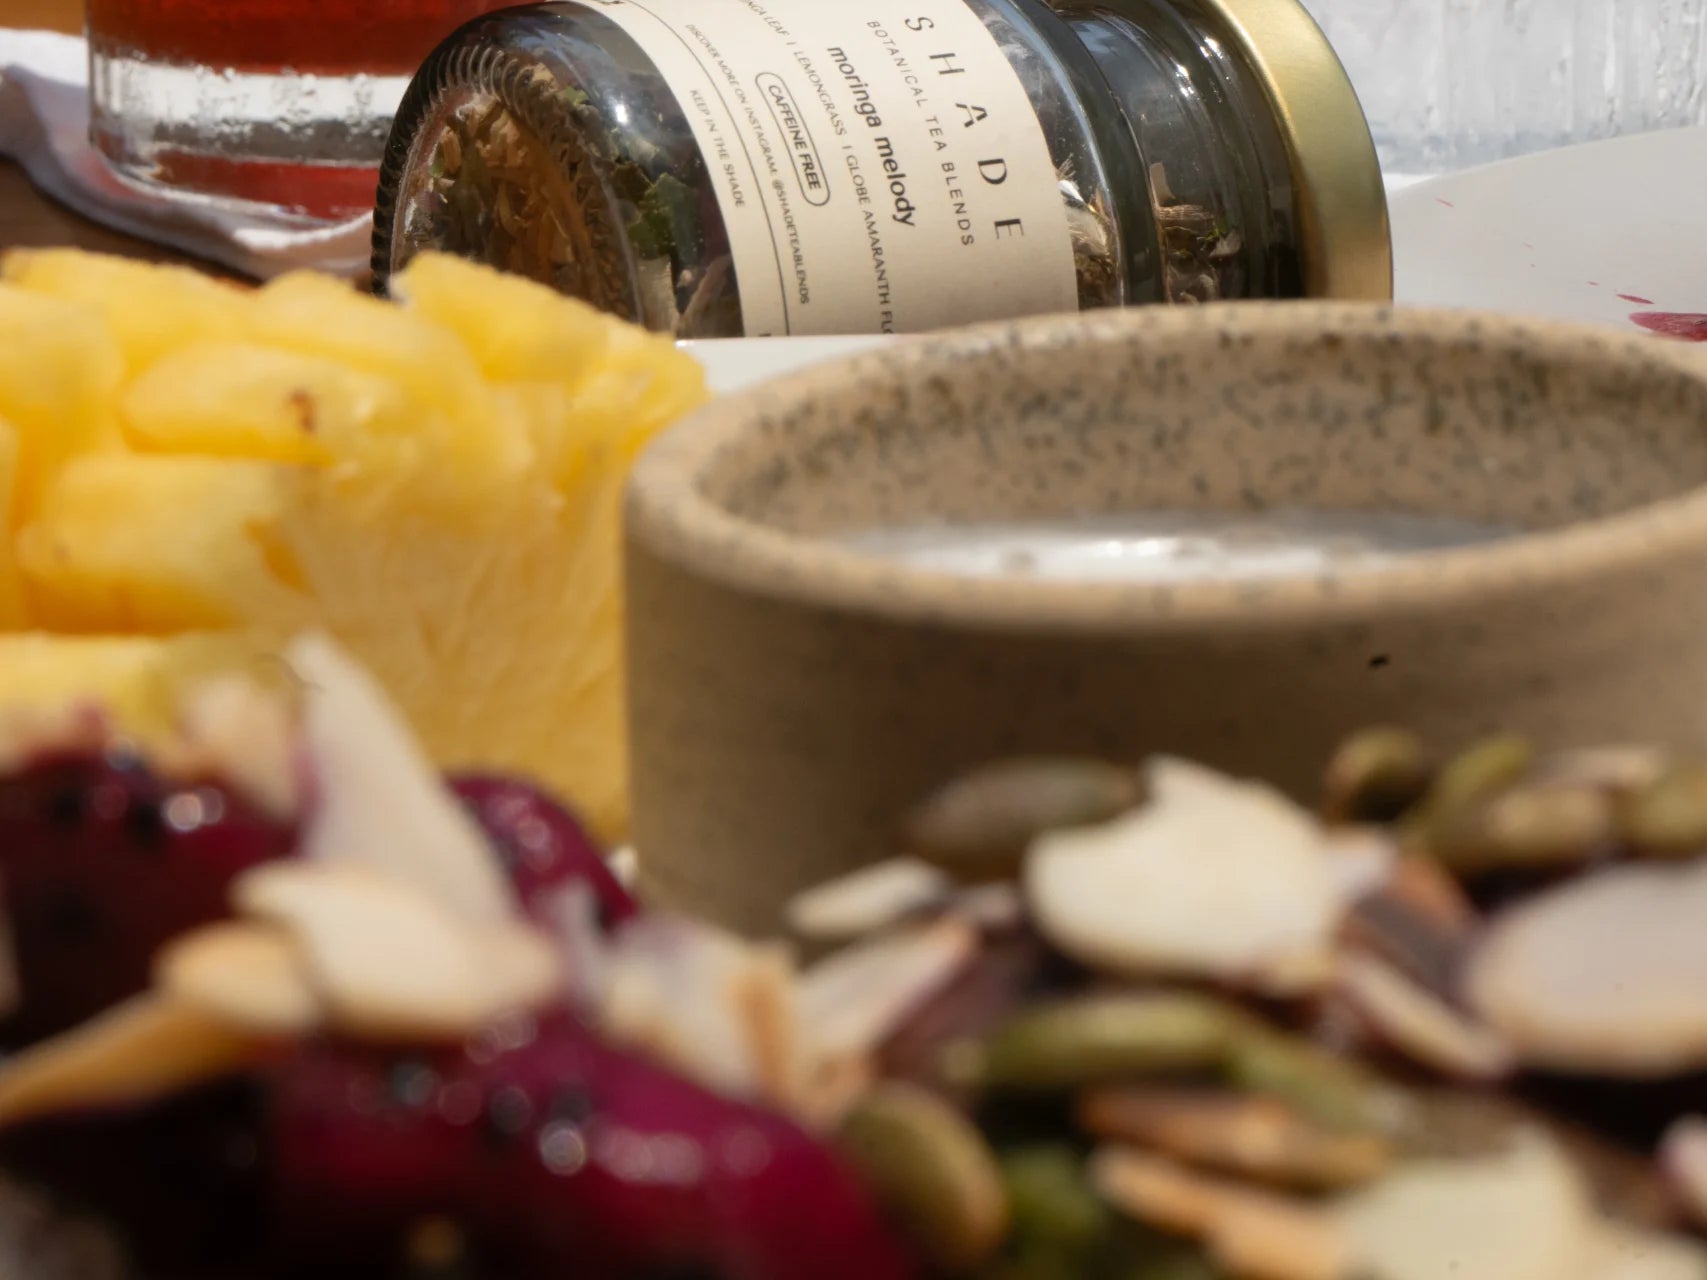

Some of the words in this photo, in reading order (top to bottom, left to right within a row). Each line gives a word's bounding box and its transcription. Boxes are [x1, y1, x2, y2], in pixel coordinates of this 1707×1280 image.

[684, 23, 721, 59] DISCOVER
[716, 59, 740, 88] MORE
[734, 86, 749, 105] ON
[771, 178, 810, 305] @SHADETEABLENDS
[689, 88, 711, 117] KEEP
[704, 118, 718, 134] IN
[713, 136, 730, 161] THE
[723, 163, 746, 209] SHADE
[763, 16, 790, 36] LEAF
[793, 50, 847, 136] LEMONGRASS
[846, 155, 871, 205] GLOBE
[862, 209, 891, 305] AMARANTH
[768, 84, 808, 151] CAFFEINE
[798, 153, 821, 190] FREE
[827, 46, 882, 128] moringa
[874, 137, 916, 227] melody
[866, 20, 929, 107] BOTANICAL
[925, 115, 947, 151] TEA
[941, 162, 974, 246] BLENDS
[904, 16, 1024, 240] SHADE
